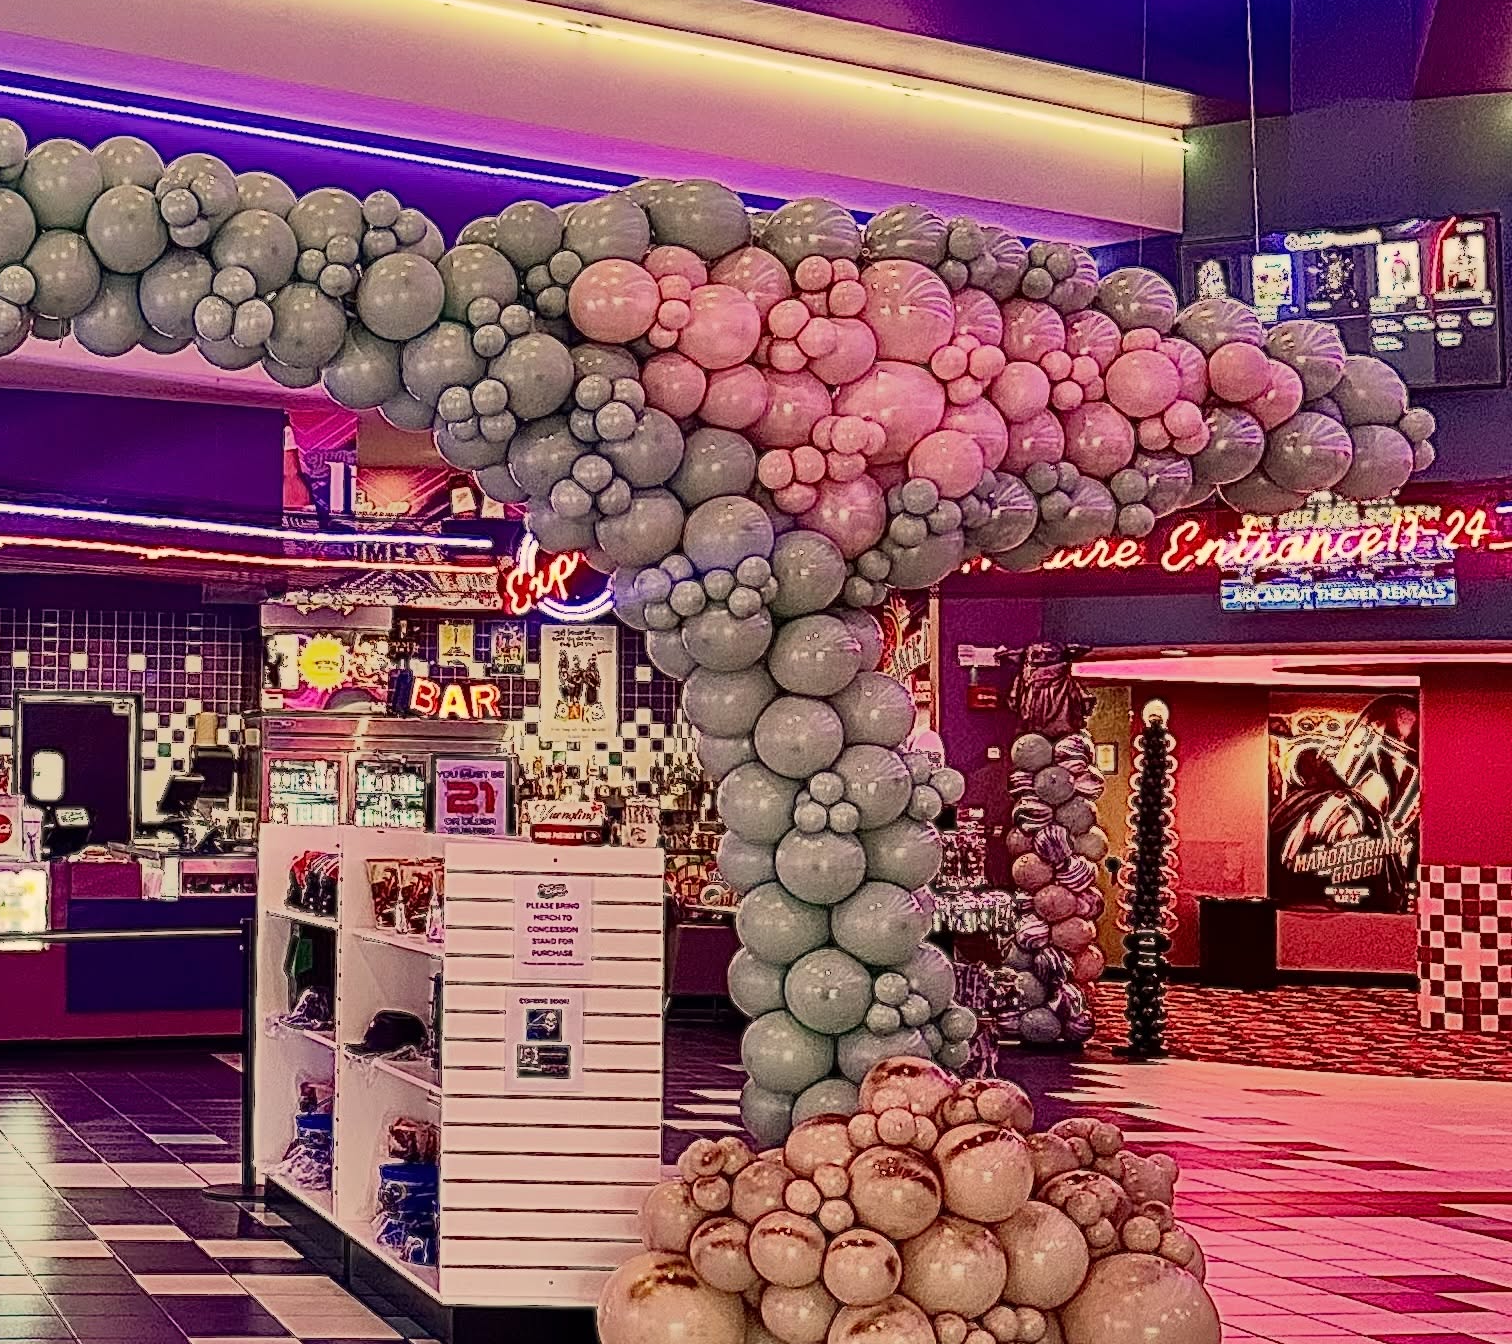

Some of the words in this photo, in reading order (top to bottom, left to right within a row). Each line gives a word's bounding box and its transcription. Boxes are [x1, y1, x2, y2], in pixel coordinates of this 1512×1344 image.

[1161, 514, 1388, 572] Entrance
[1317, 586, 1378, 601] THEATER
[1381, 584, 1447, 600] RENTALS
[410, 676, 503, 720] BAR
[436, 770, 459, 779] YOU
[491, 770, 505, 779] BE
[446, 781, 495, 814] 21
[1294, 835, 1406, 873] MANDALORIAN
[1331, 857, 1384, 884] GROGU
[562, 914, 573, 922] TO
